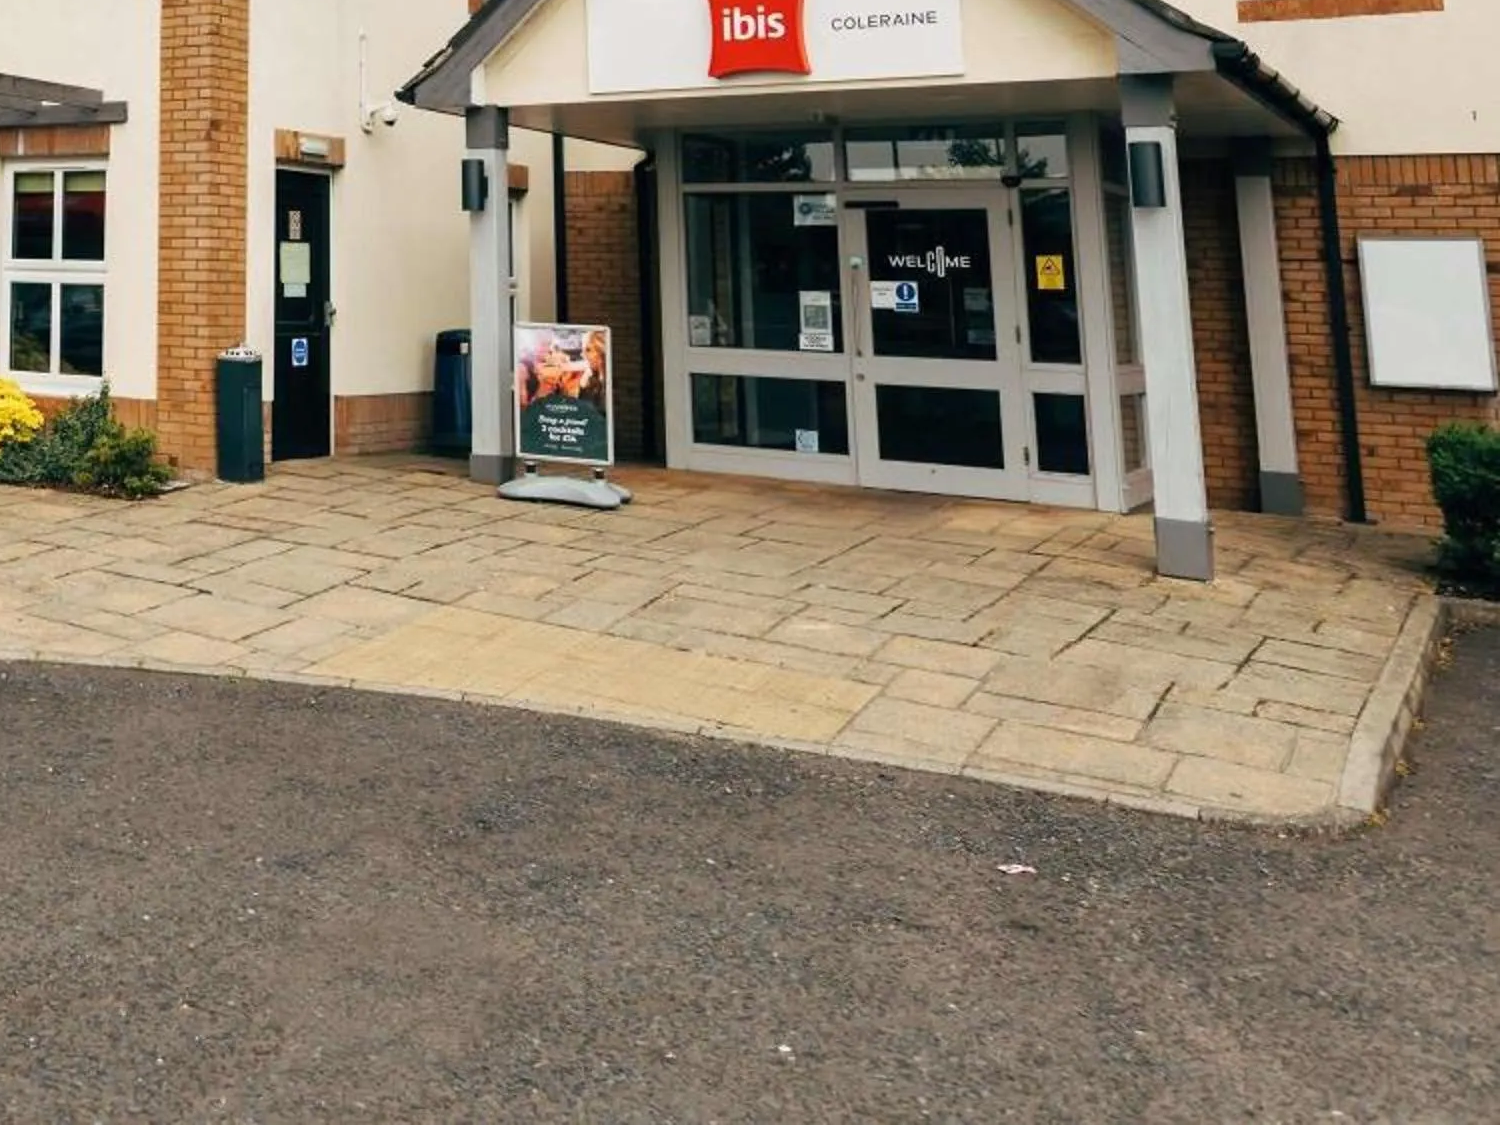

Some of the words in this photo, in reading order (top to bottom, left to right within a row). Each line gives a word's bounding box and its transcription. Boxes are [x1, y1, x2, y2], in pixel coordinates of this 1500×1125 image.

[722, 4, 786, 42] ibis
[831, 10, 938, 32] COLERAINE
[887, 245, 972, 278] WELCOME
